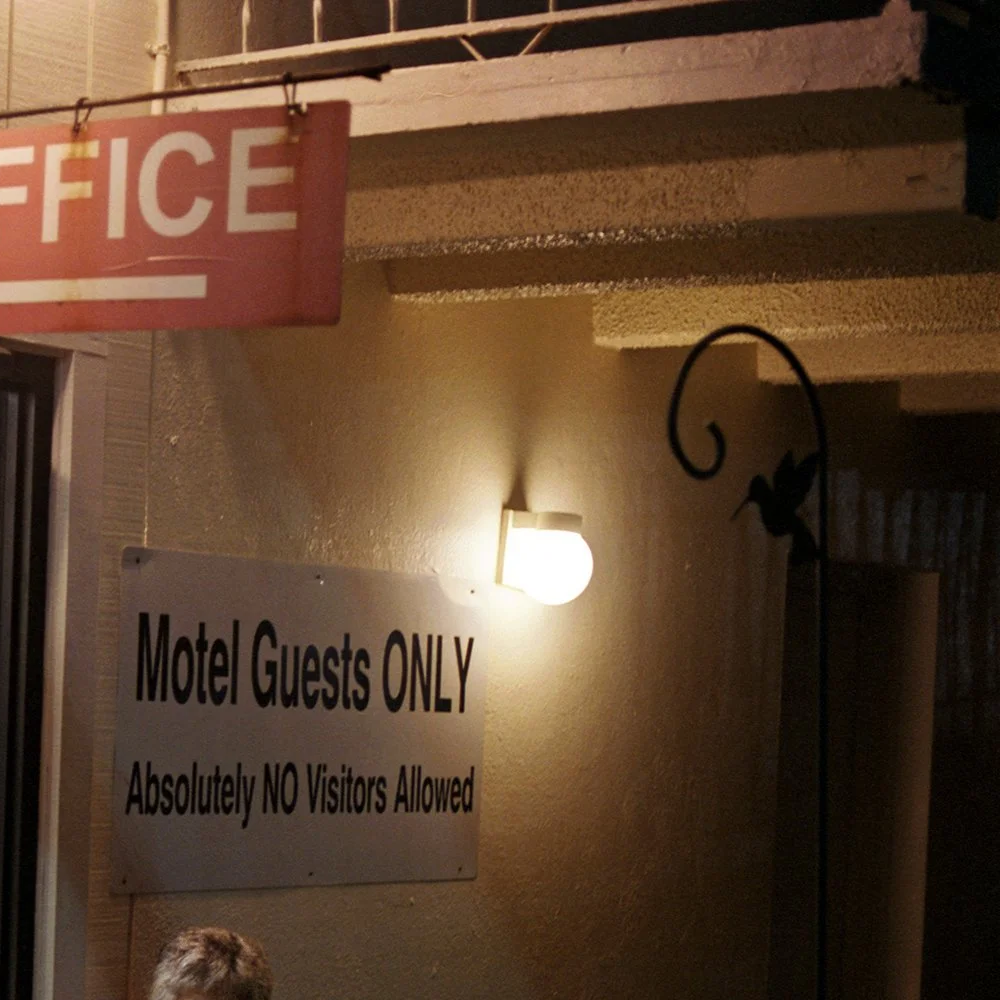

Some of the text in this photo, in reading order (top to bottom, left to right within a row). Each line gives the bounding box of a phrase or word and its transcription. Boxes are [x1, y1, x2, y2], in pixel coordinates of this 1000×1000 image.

[136, 612, 475, 713] Motel Guests ONLY
[125, 761, 475, 829] Absolutely NO Visitors Allowed
